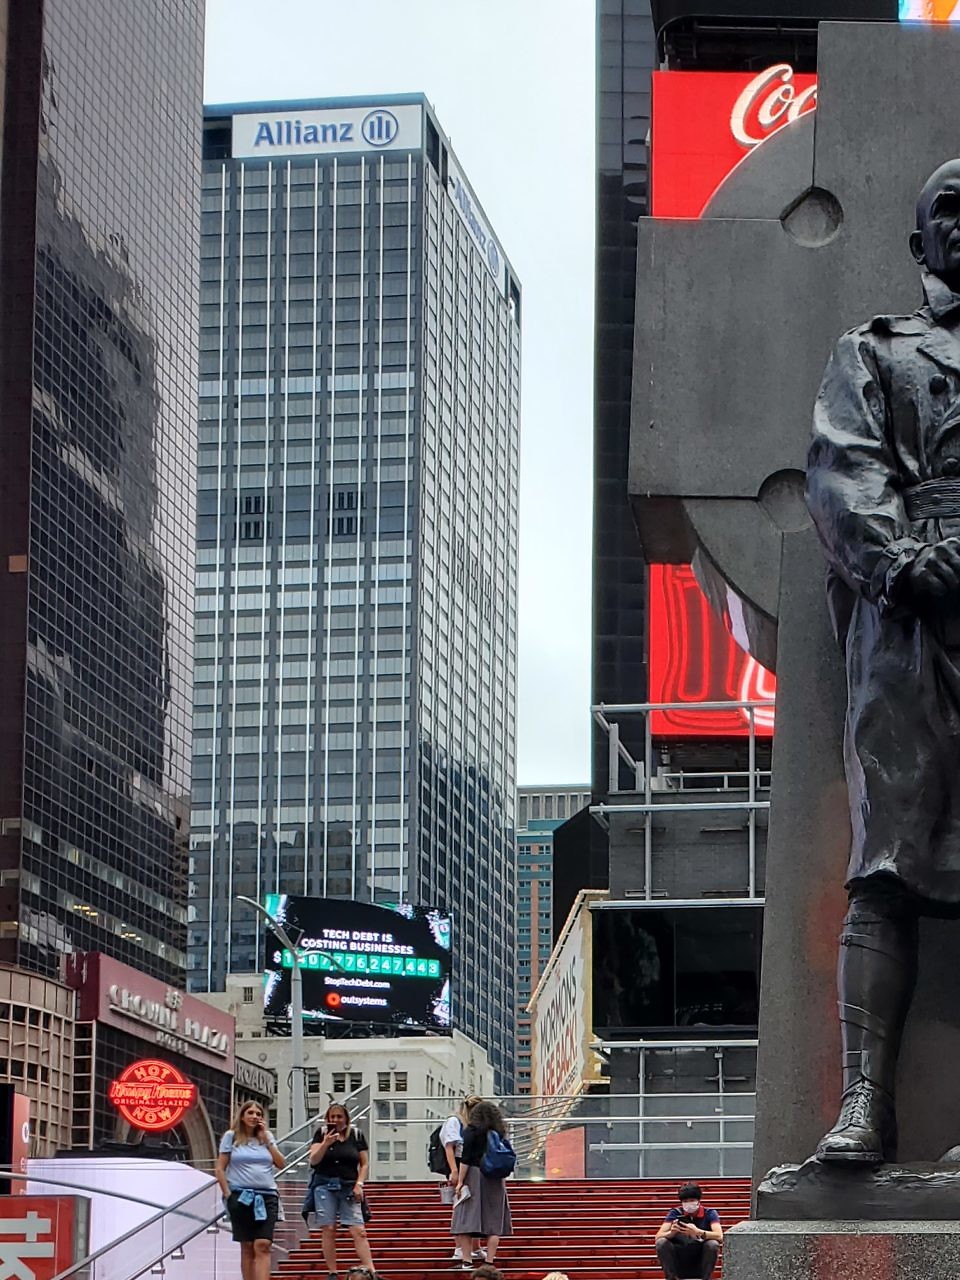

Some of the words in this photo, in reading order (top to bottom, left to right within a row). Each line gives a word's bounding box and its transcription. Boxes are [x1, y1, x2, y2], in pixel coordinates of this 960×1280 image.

[254, 119, 354, 147] Allianz
[322, 929, 350, 939] TECH
[352, 931, 379, 942] DEBT
[381, 933, 393, 942] IS
[301, 938, 347, 950] COSTING
[350, 943, 414, 955] BUSINESSES
[324, 977, 390, 989] StopTechDebt.com
[341, 995, 387, 1006] outsystems
[540, 955, 577, 1065] MORMONS
[134, 1065, 170, 1080] HOT
[132, 1107, 171, 1123] NOW
